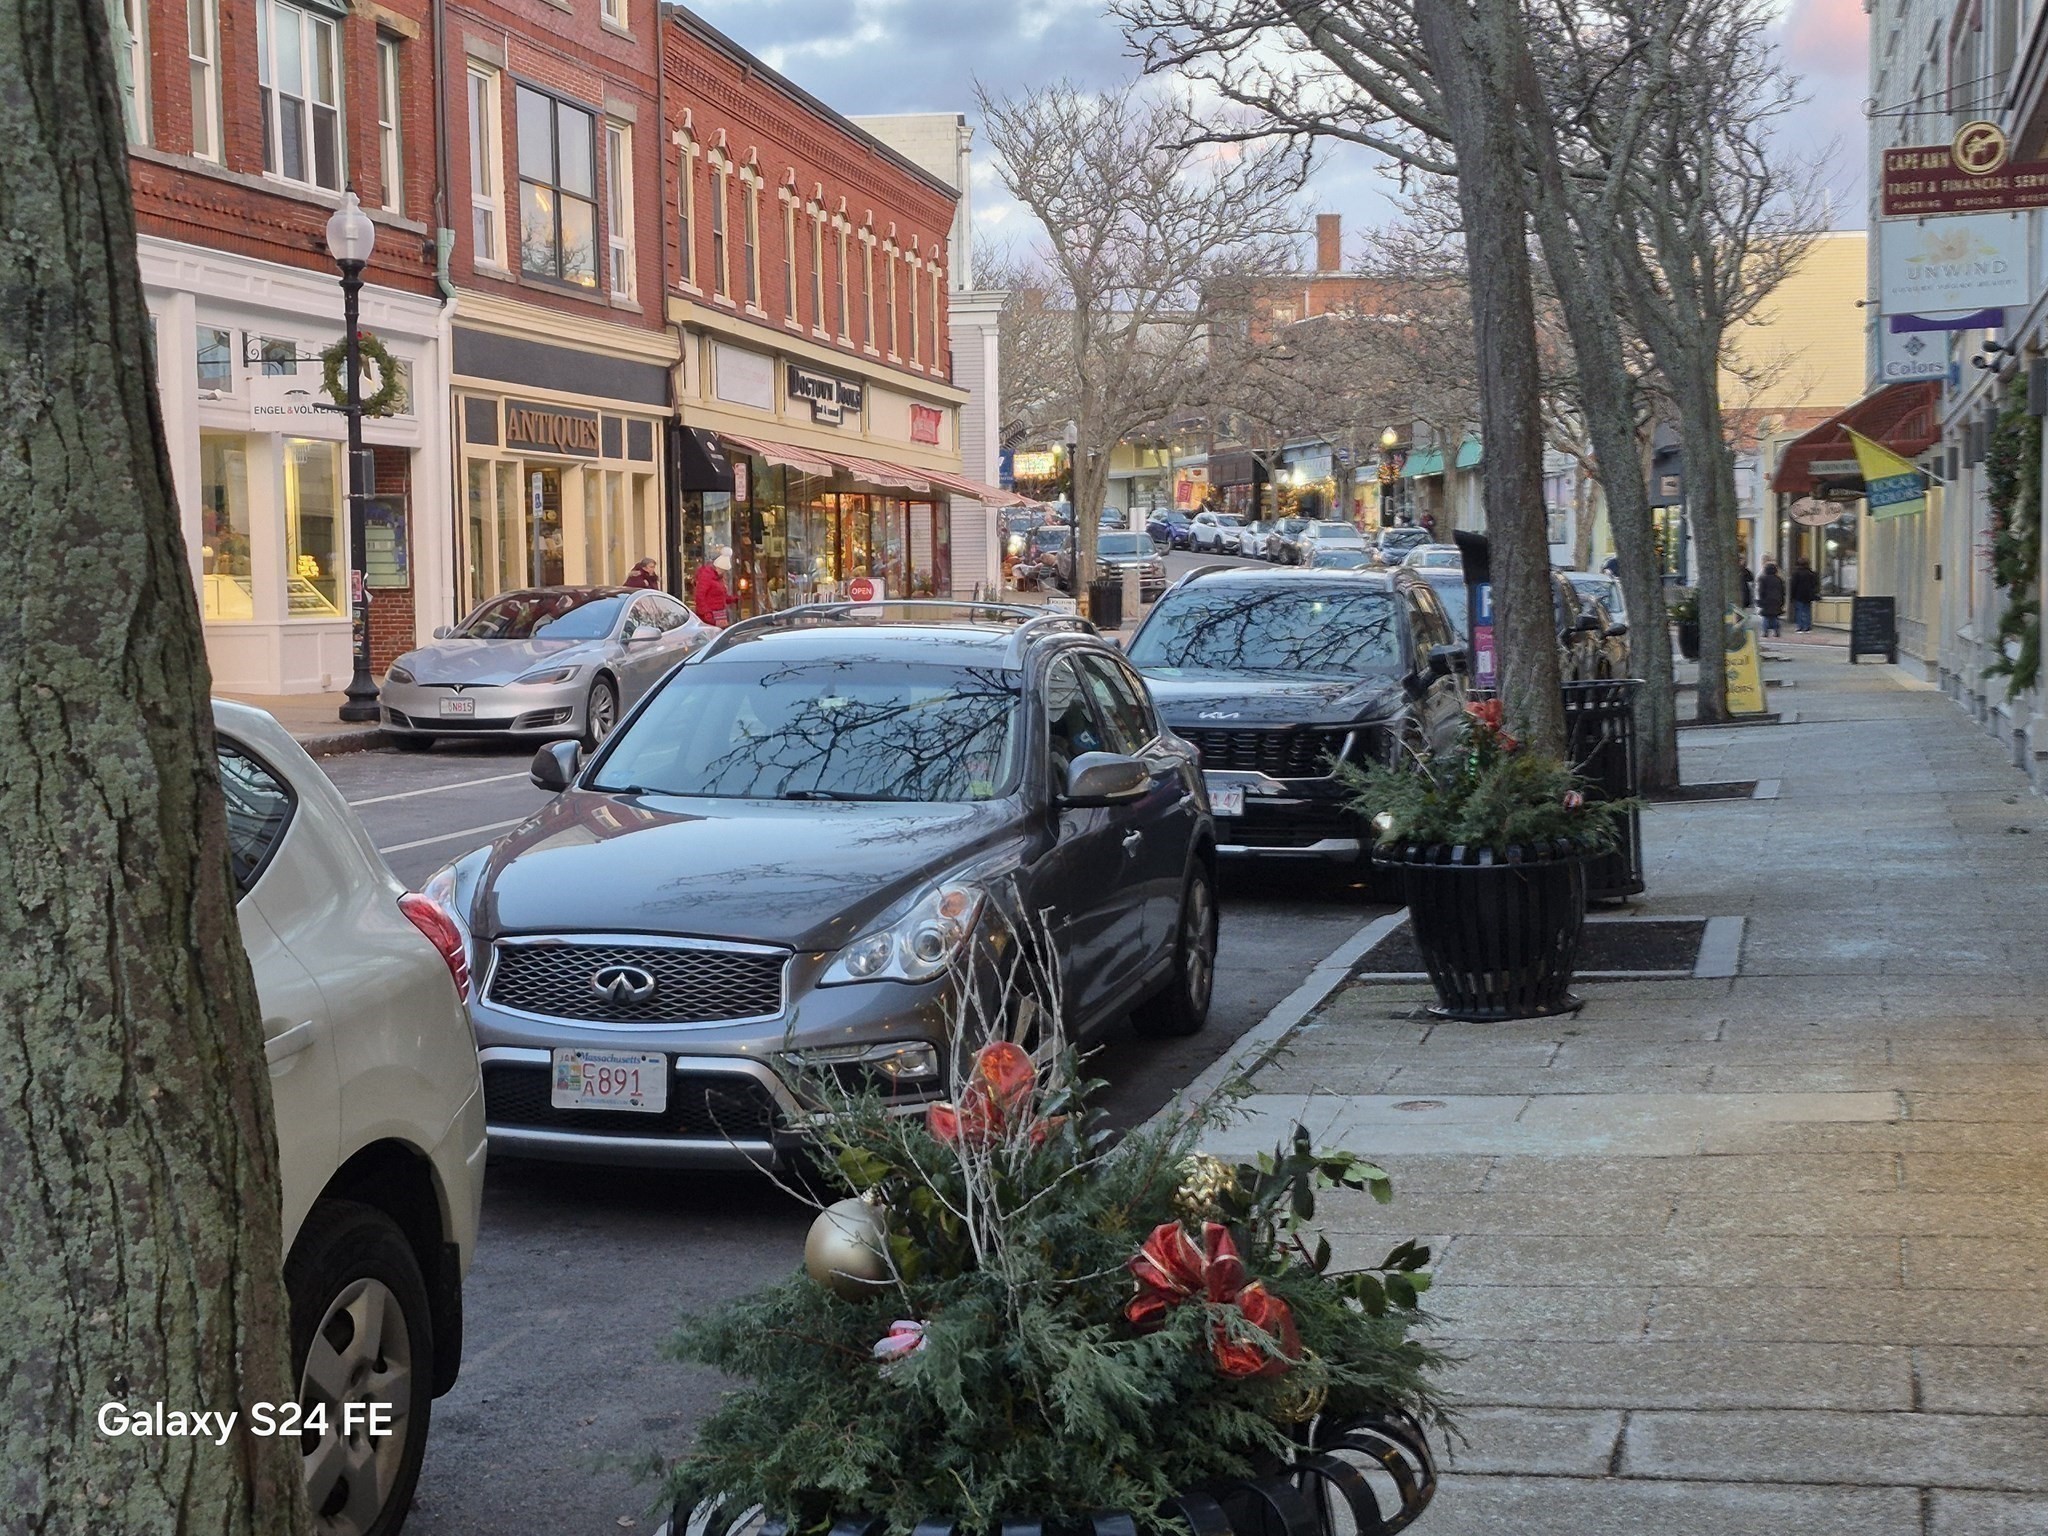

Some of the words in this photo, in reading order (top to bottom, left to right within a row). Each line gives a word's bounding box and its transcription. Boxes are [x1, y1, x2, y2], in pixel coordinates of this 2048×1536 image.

[1906, 260, 2007, 280] UNWIND
[1886, 360, 1944, 377] Colors
[254, 406, 286, 414] ENGEL
[506, 407, 598, 453] ANTIQUES
[851, 587, 872, 595] OPEN
[580, 1052, 641, 1064] Massachusetts
